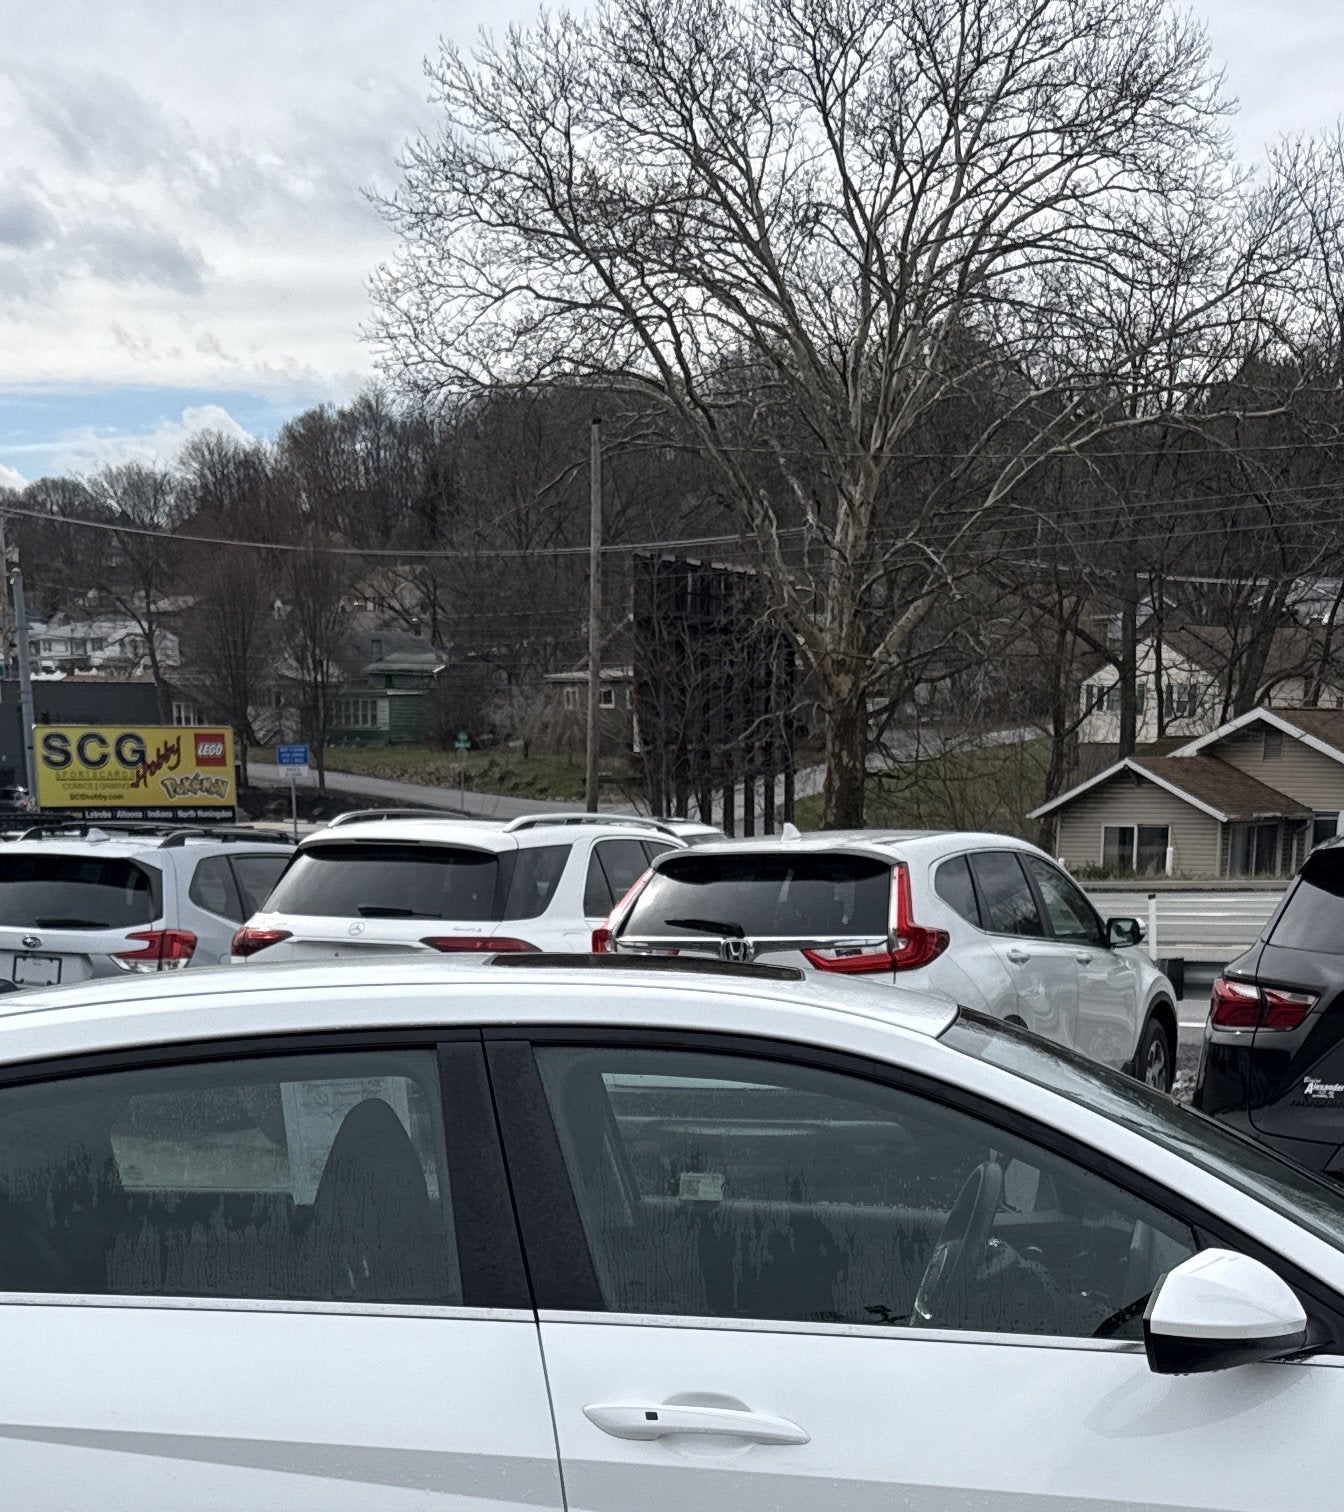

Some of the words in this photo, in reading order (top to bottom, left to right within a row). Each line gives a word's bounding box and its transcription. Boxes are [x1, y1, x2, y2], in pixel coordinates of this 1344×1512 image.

[42, 732, 146, 770] SCG
[130, 735, 181, 788] Hobby
[197, 742, 223, 755] LEGO
